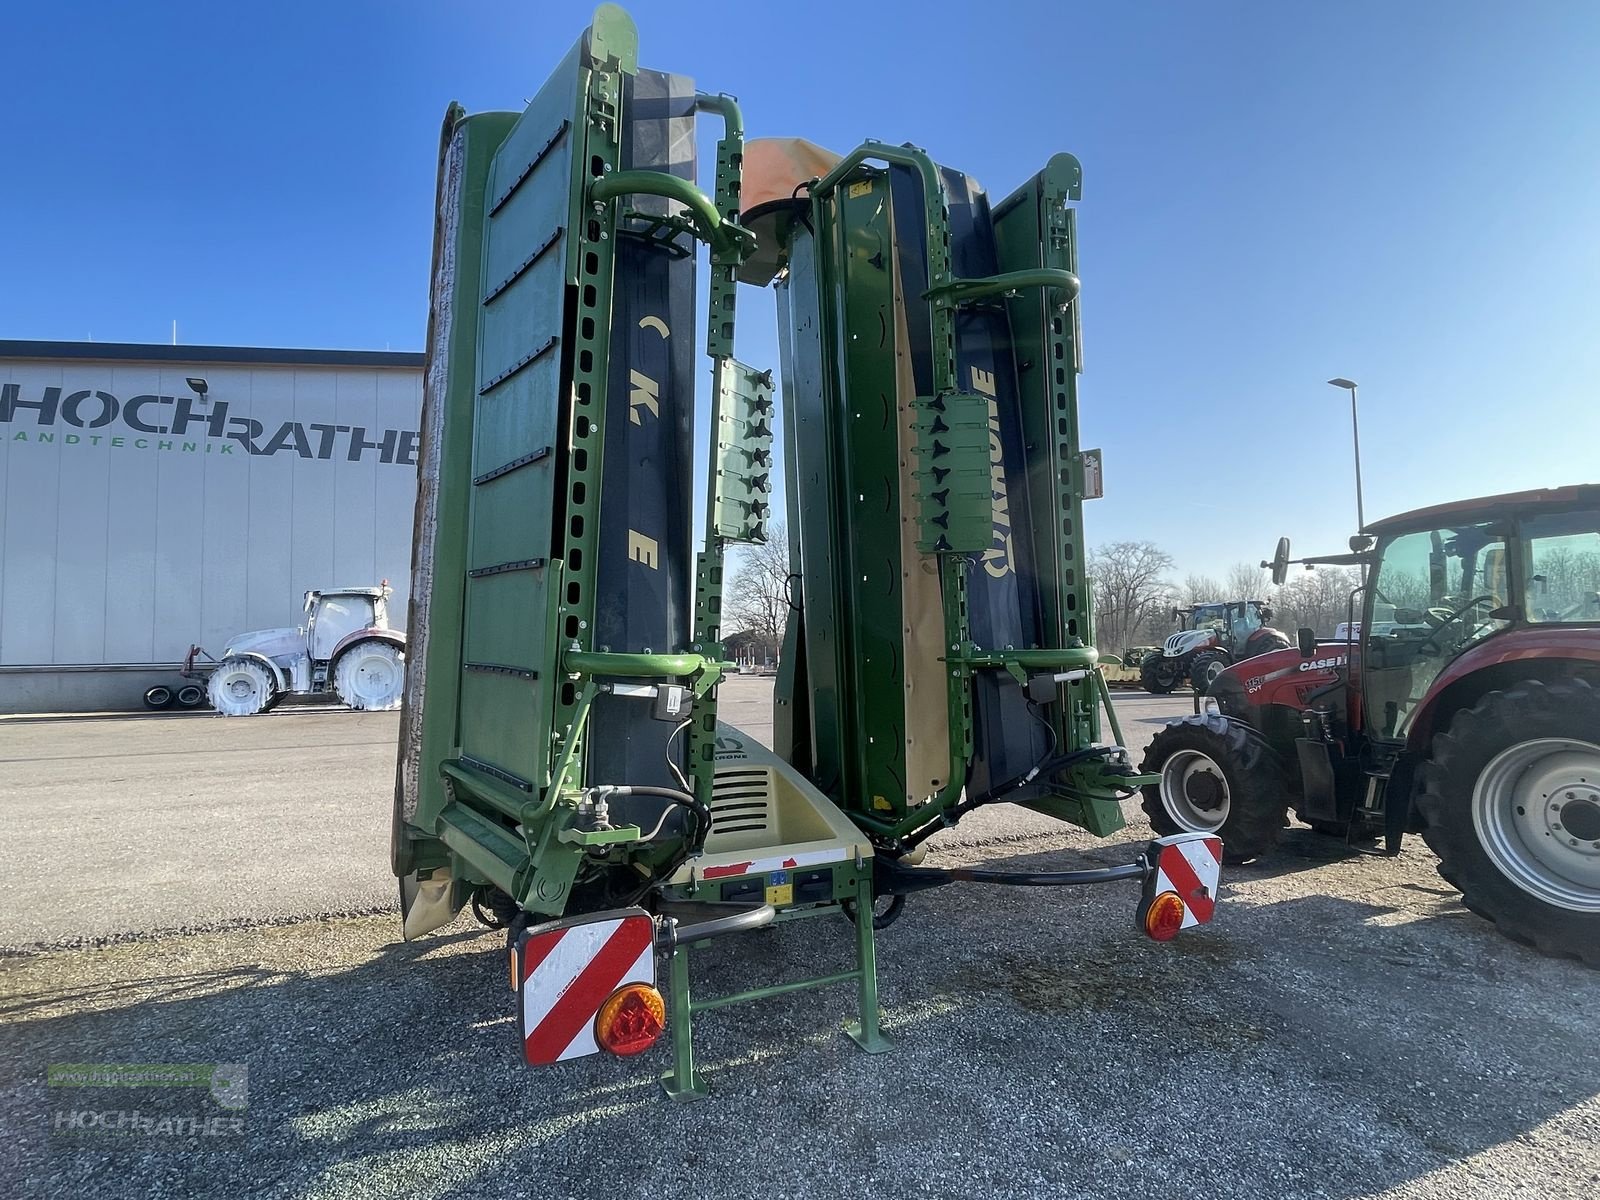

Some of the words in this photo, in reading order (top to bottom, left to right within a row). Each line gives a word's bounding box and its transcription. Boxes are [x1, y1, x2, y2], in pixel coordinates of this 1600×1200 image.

[0, 383, 420, 466] HOCHRATHE
[0, 431, 233, 455] ANDTECHNIK
[1299, 657, 1336, 672] CASE
[1248, 684, 1262, 694] CVT
